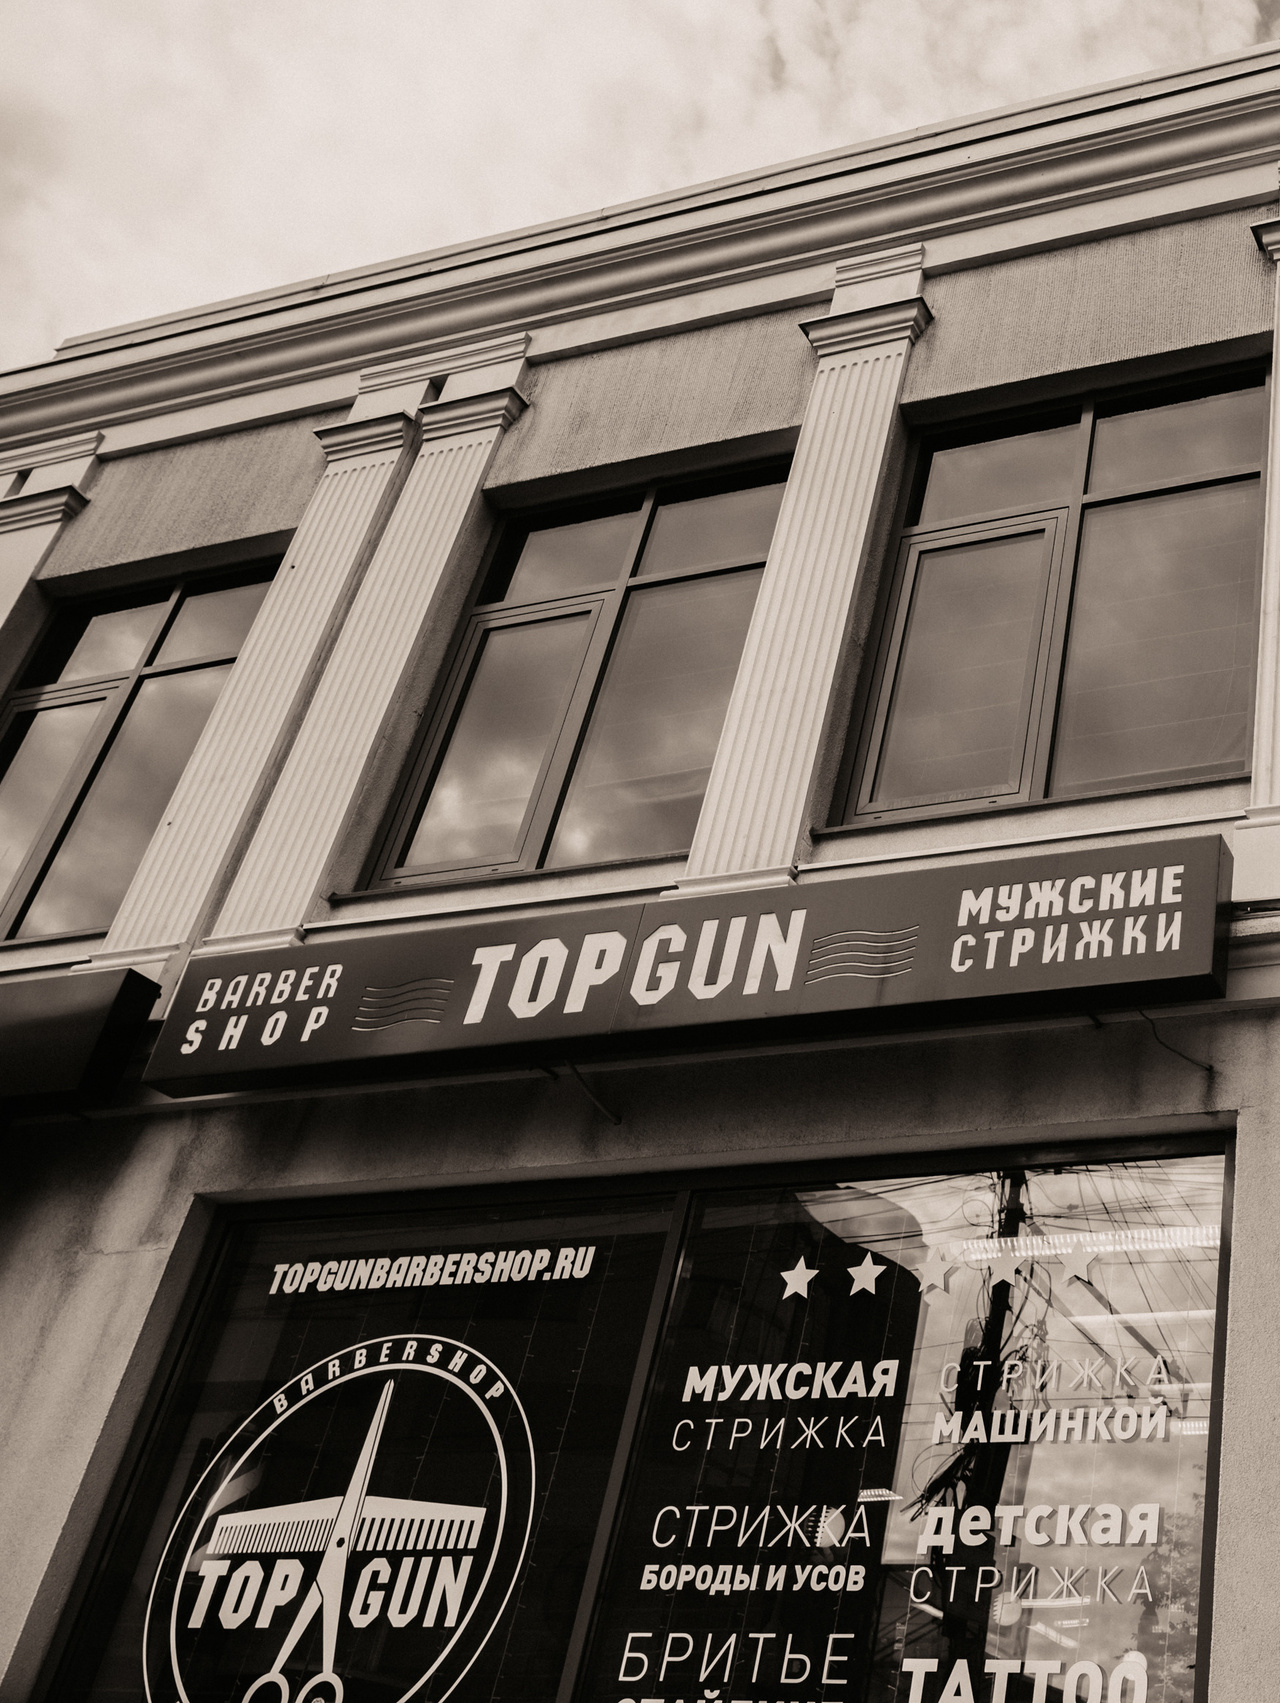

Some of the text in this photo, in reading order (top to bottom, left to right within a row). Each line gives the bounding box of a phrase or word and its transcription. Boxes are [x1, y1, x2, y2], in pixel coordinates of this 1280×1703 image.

[957, 864, 1185, 927] МУЖСКИЕ
[462, 908, 807, 1025] TOPGUN
[950, 910, 1182, 973] СТРИЖКИ
[195, 963, 344, 1013] BARBER
[180, 1005, 329, 1055] SHOP
[269, 1246, 596, 1295] TOPGUNBARBERSHOP.RU
[272, 1340, 506, 1415] BARBERSHOP
[681, 1359, 900, 1402] МУЖСКАЯ
[940, 1354, 1170, 1393] СТРИЖКА
[672, 1415, 887, 1452] СТРИЖКА
[931, 1396, 1168, 1445] МАШИНКОЙ
[652, 1504, 872, 1548] СТРИЖКА
[915, 1503, 1161, 1555] детская
[187, 1555, 474, 1630] TOP GUN
[639, 1564, 866, 1596] БОРОДЫ И УСОВ
[909, 1565, 1153, 1603] СТРИЖКА
[618, 1632, 855, 1685] БРИТЬЕ
